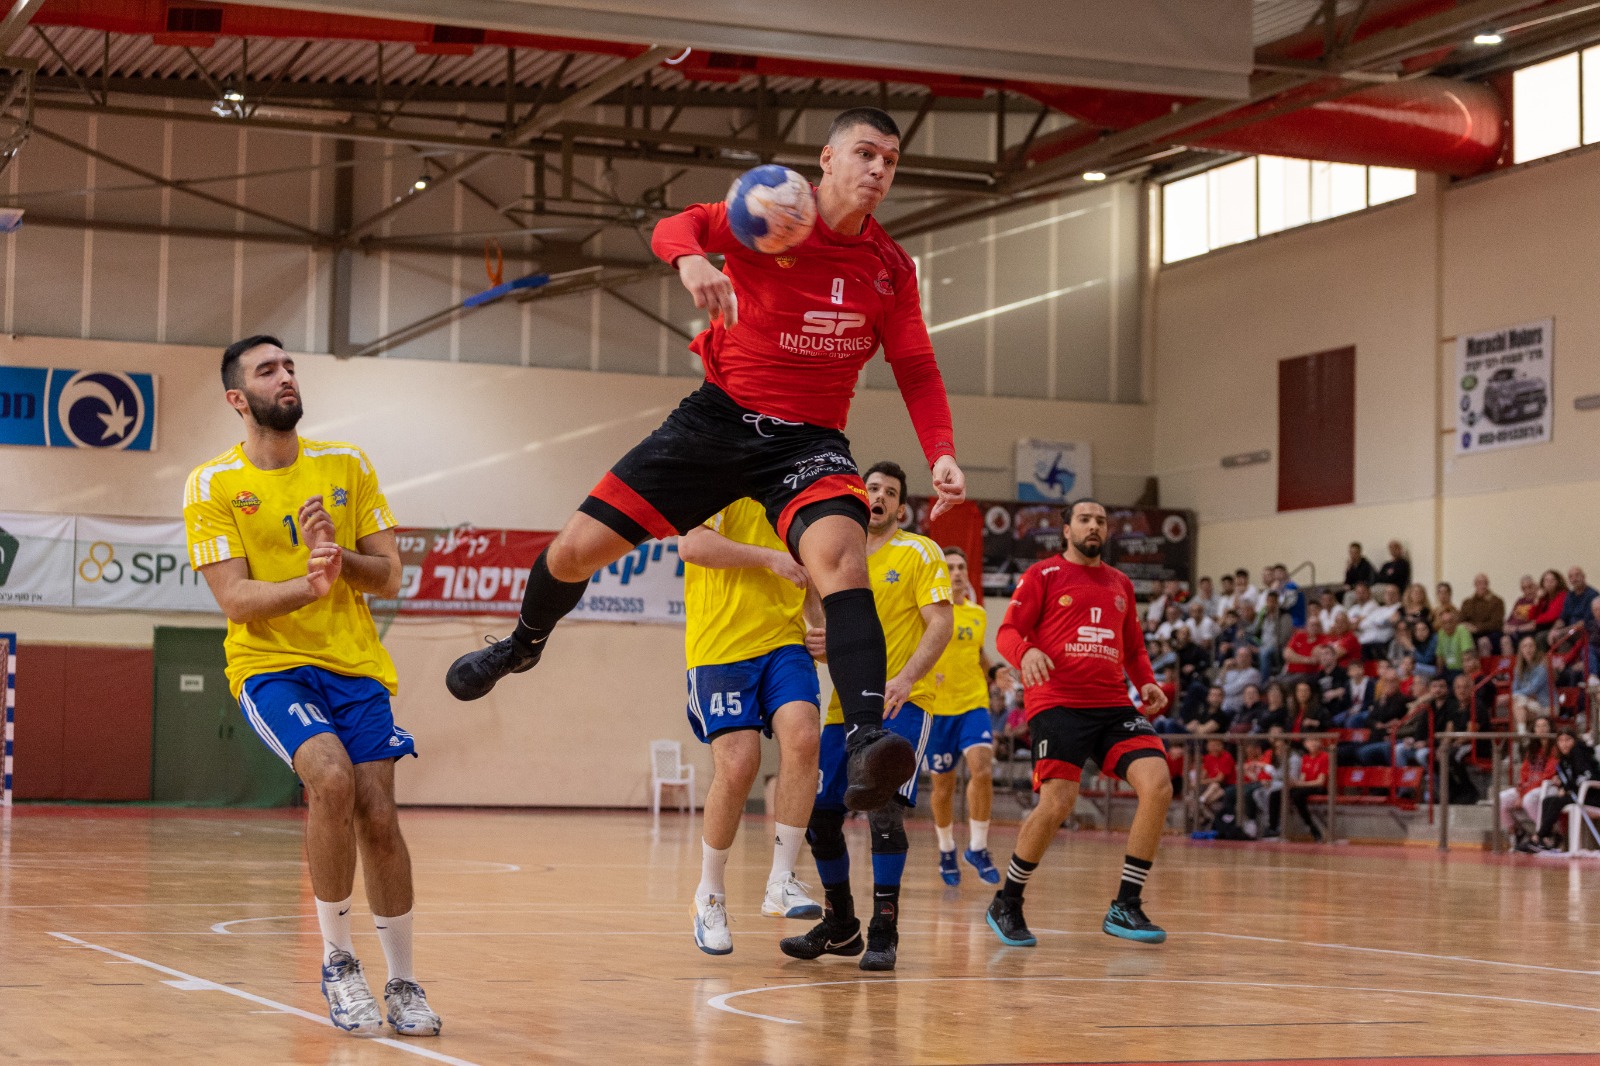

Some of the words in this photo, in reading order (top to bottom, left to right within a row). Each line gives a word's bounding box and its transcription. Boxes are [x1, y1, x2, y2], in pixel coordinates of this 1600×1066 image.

[831, 278, 844, 304] 9
[802, 311, 866, 336] SP
[780, 332, 872, 351] INDUSTRIES
[232, 500, 261, 508] Winner
[282, 514, 299, 547] 1
[1091, 608, 1101, 623] 17
[957, 627, 973, 640] 29
[1077, 626, 1115, 643] SP
[710, 692, 742, 716] 45
[288, 703, 330, 726] 10
[1039, 739, 1048, 758] 17
[933, 753, 953, 769] 29
